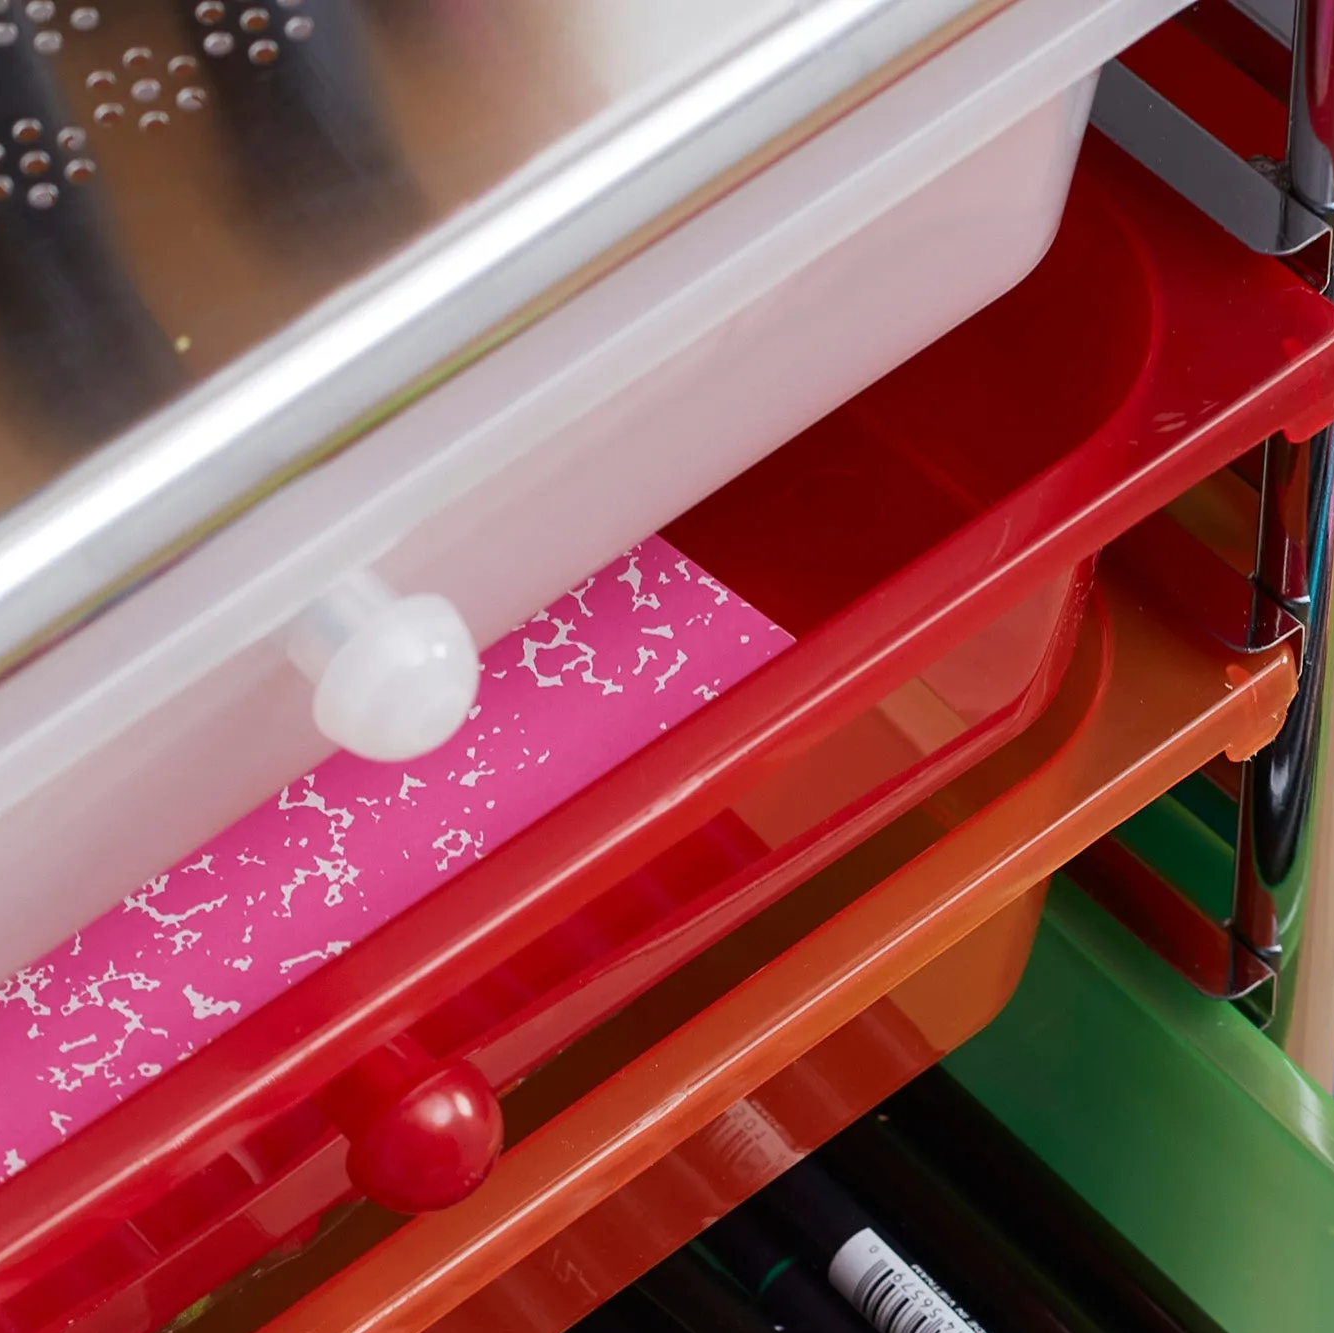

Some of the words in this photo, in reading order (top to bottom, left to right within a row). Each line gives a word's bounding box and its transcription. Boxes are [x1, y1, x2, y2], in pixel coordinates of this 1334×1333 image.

[892, 1271, 945, 1321] 56579
[910, 1263, 956, 1308] VIETNAM
[954, 1306, 970, 1320] IN
